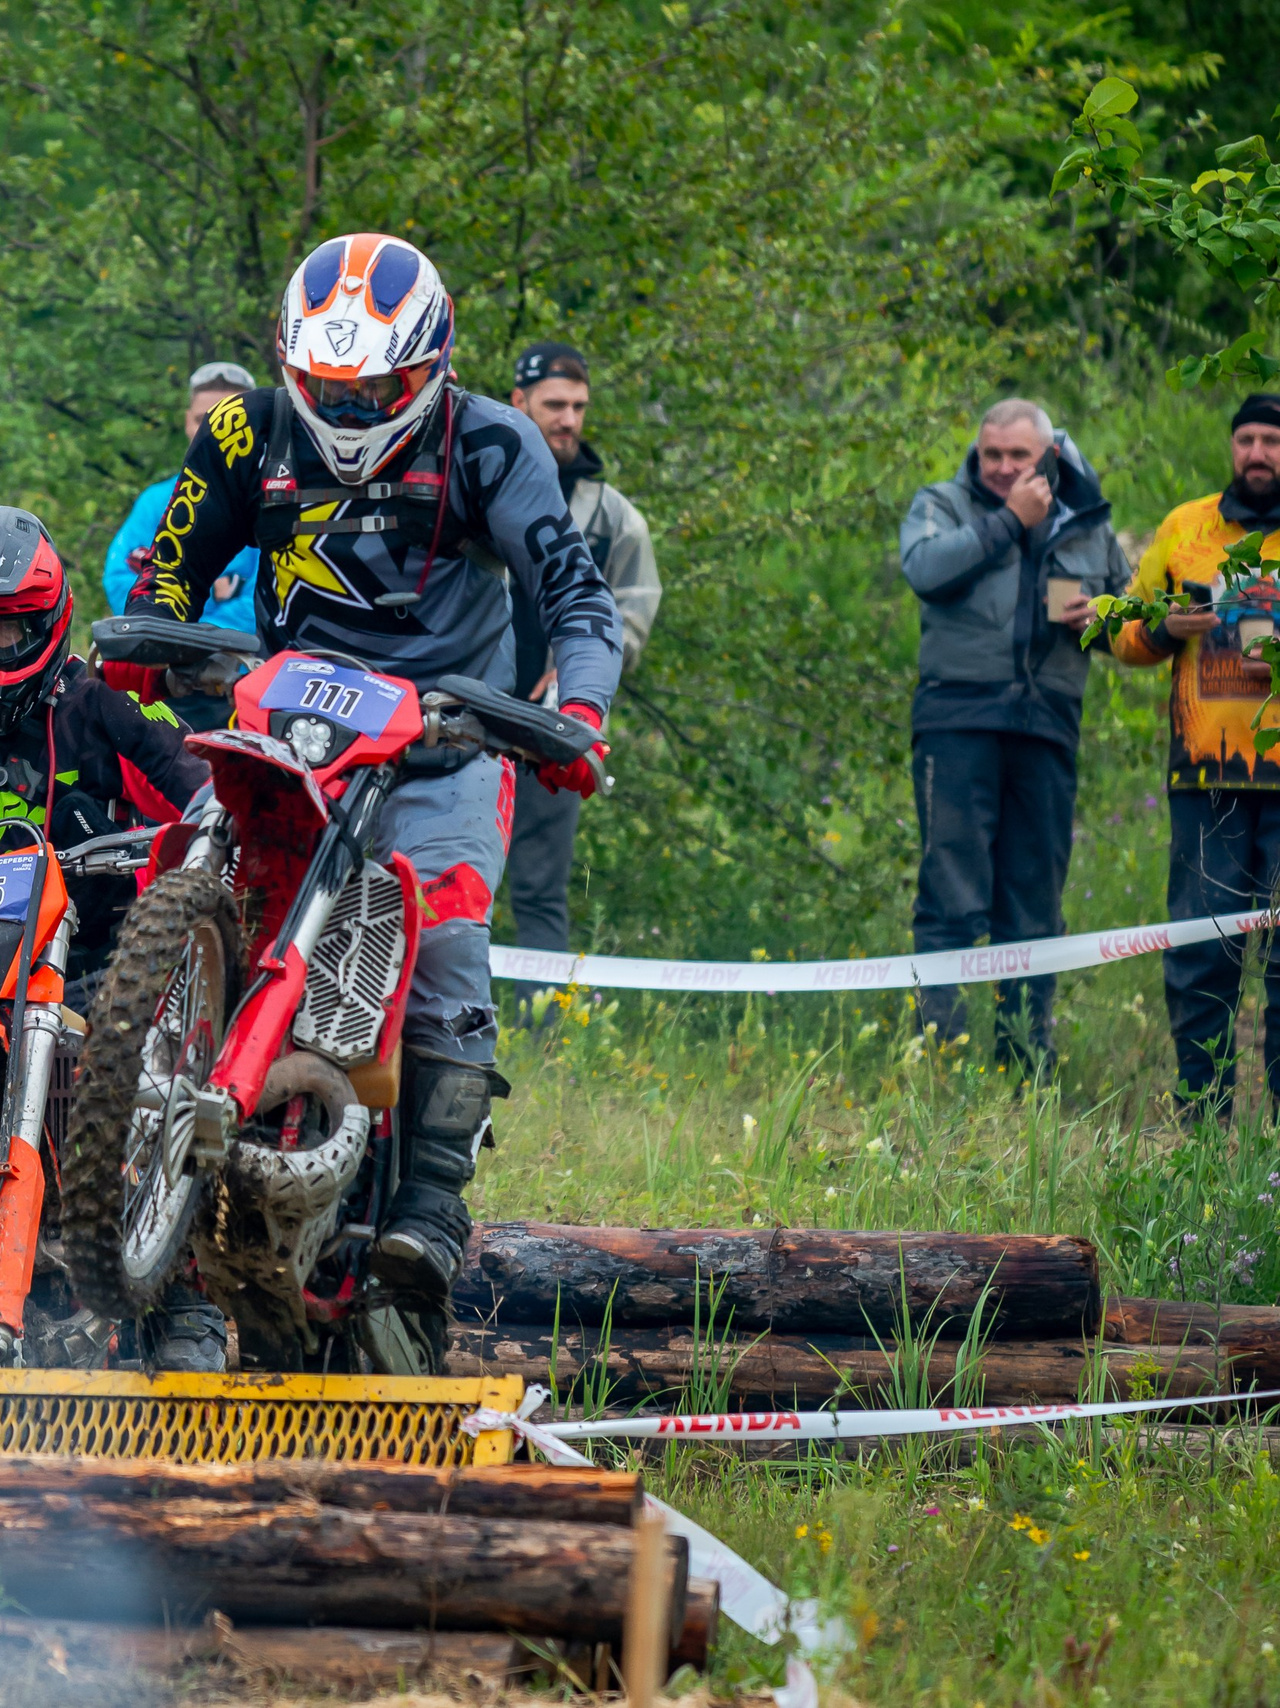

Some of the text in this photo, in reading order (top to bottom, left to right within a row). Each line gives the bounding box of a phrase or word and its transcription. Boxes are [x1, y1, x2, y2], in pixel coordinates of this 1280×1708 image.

[289, 319, 302, 354] thor
[384, 323, 401, 367] thor
[336, 434, 363, 443] thor
[266, 480, 291, 490] LEATT
[1202, 657, 1245, 679] САМА
[299, 678, 364, 719] 111
[657, 1412, 801, 1434] KENDA
